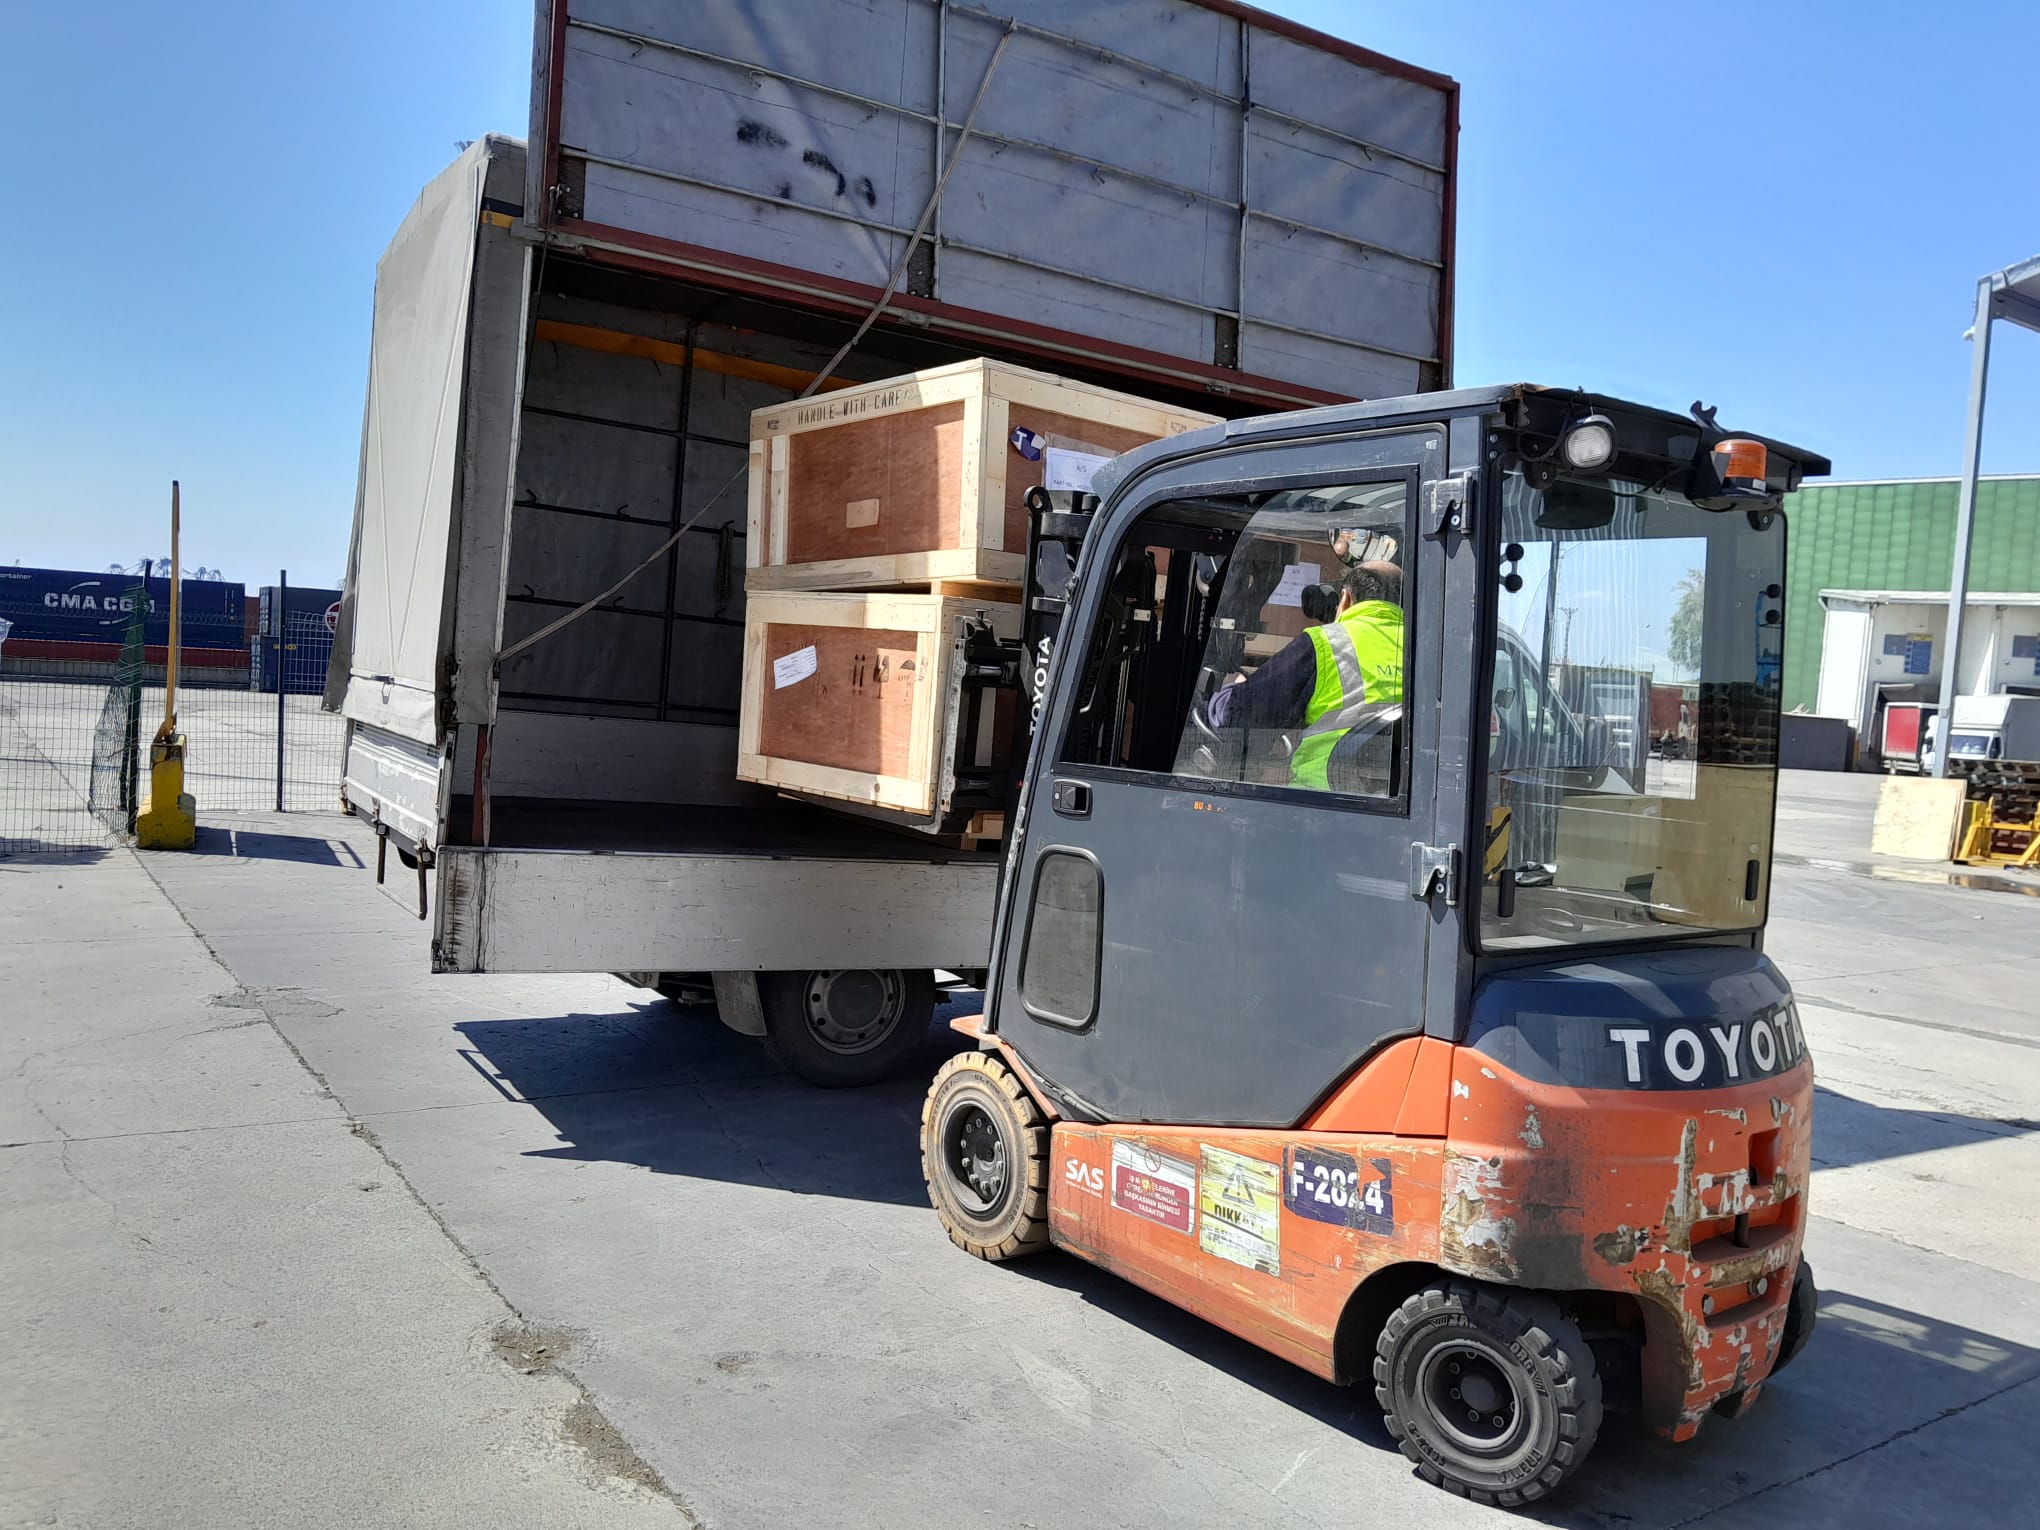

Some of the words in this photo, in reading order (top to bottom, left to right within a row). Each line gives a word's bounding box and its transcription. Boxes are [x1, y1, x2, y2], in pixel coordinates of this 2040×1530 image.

[798, 404, 835, 425] HANDLE
[843, 397, 867, 417] WITH
[874, 389, 902, 410] CARE
[44, 592, 97, 611] CMA
[1029, 635, 1051, 736] TOYOTA
[1609, 1004, 1807, 1083] TOYOTA
[1065, 1158, 1105, 1191] SAS
